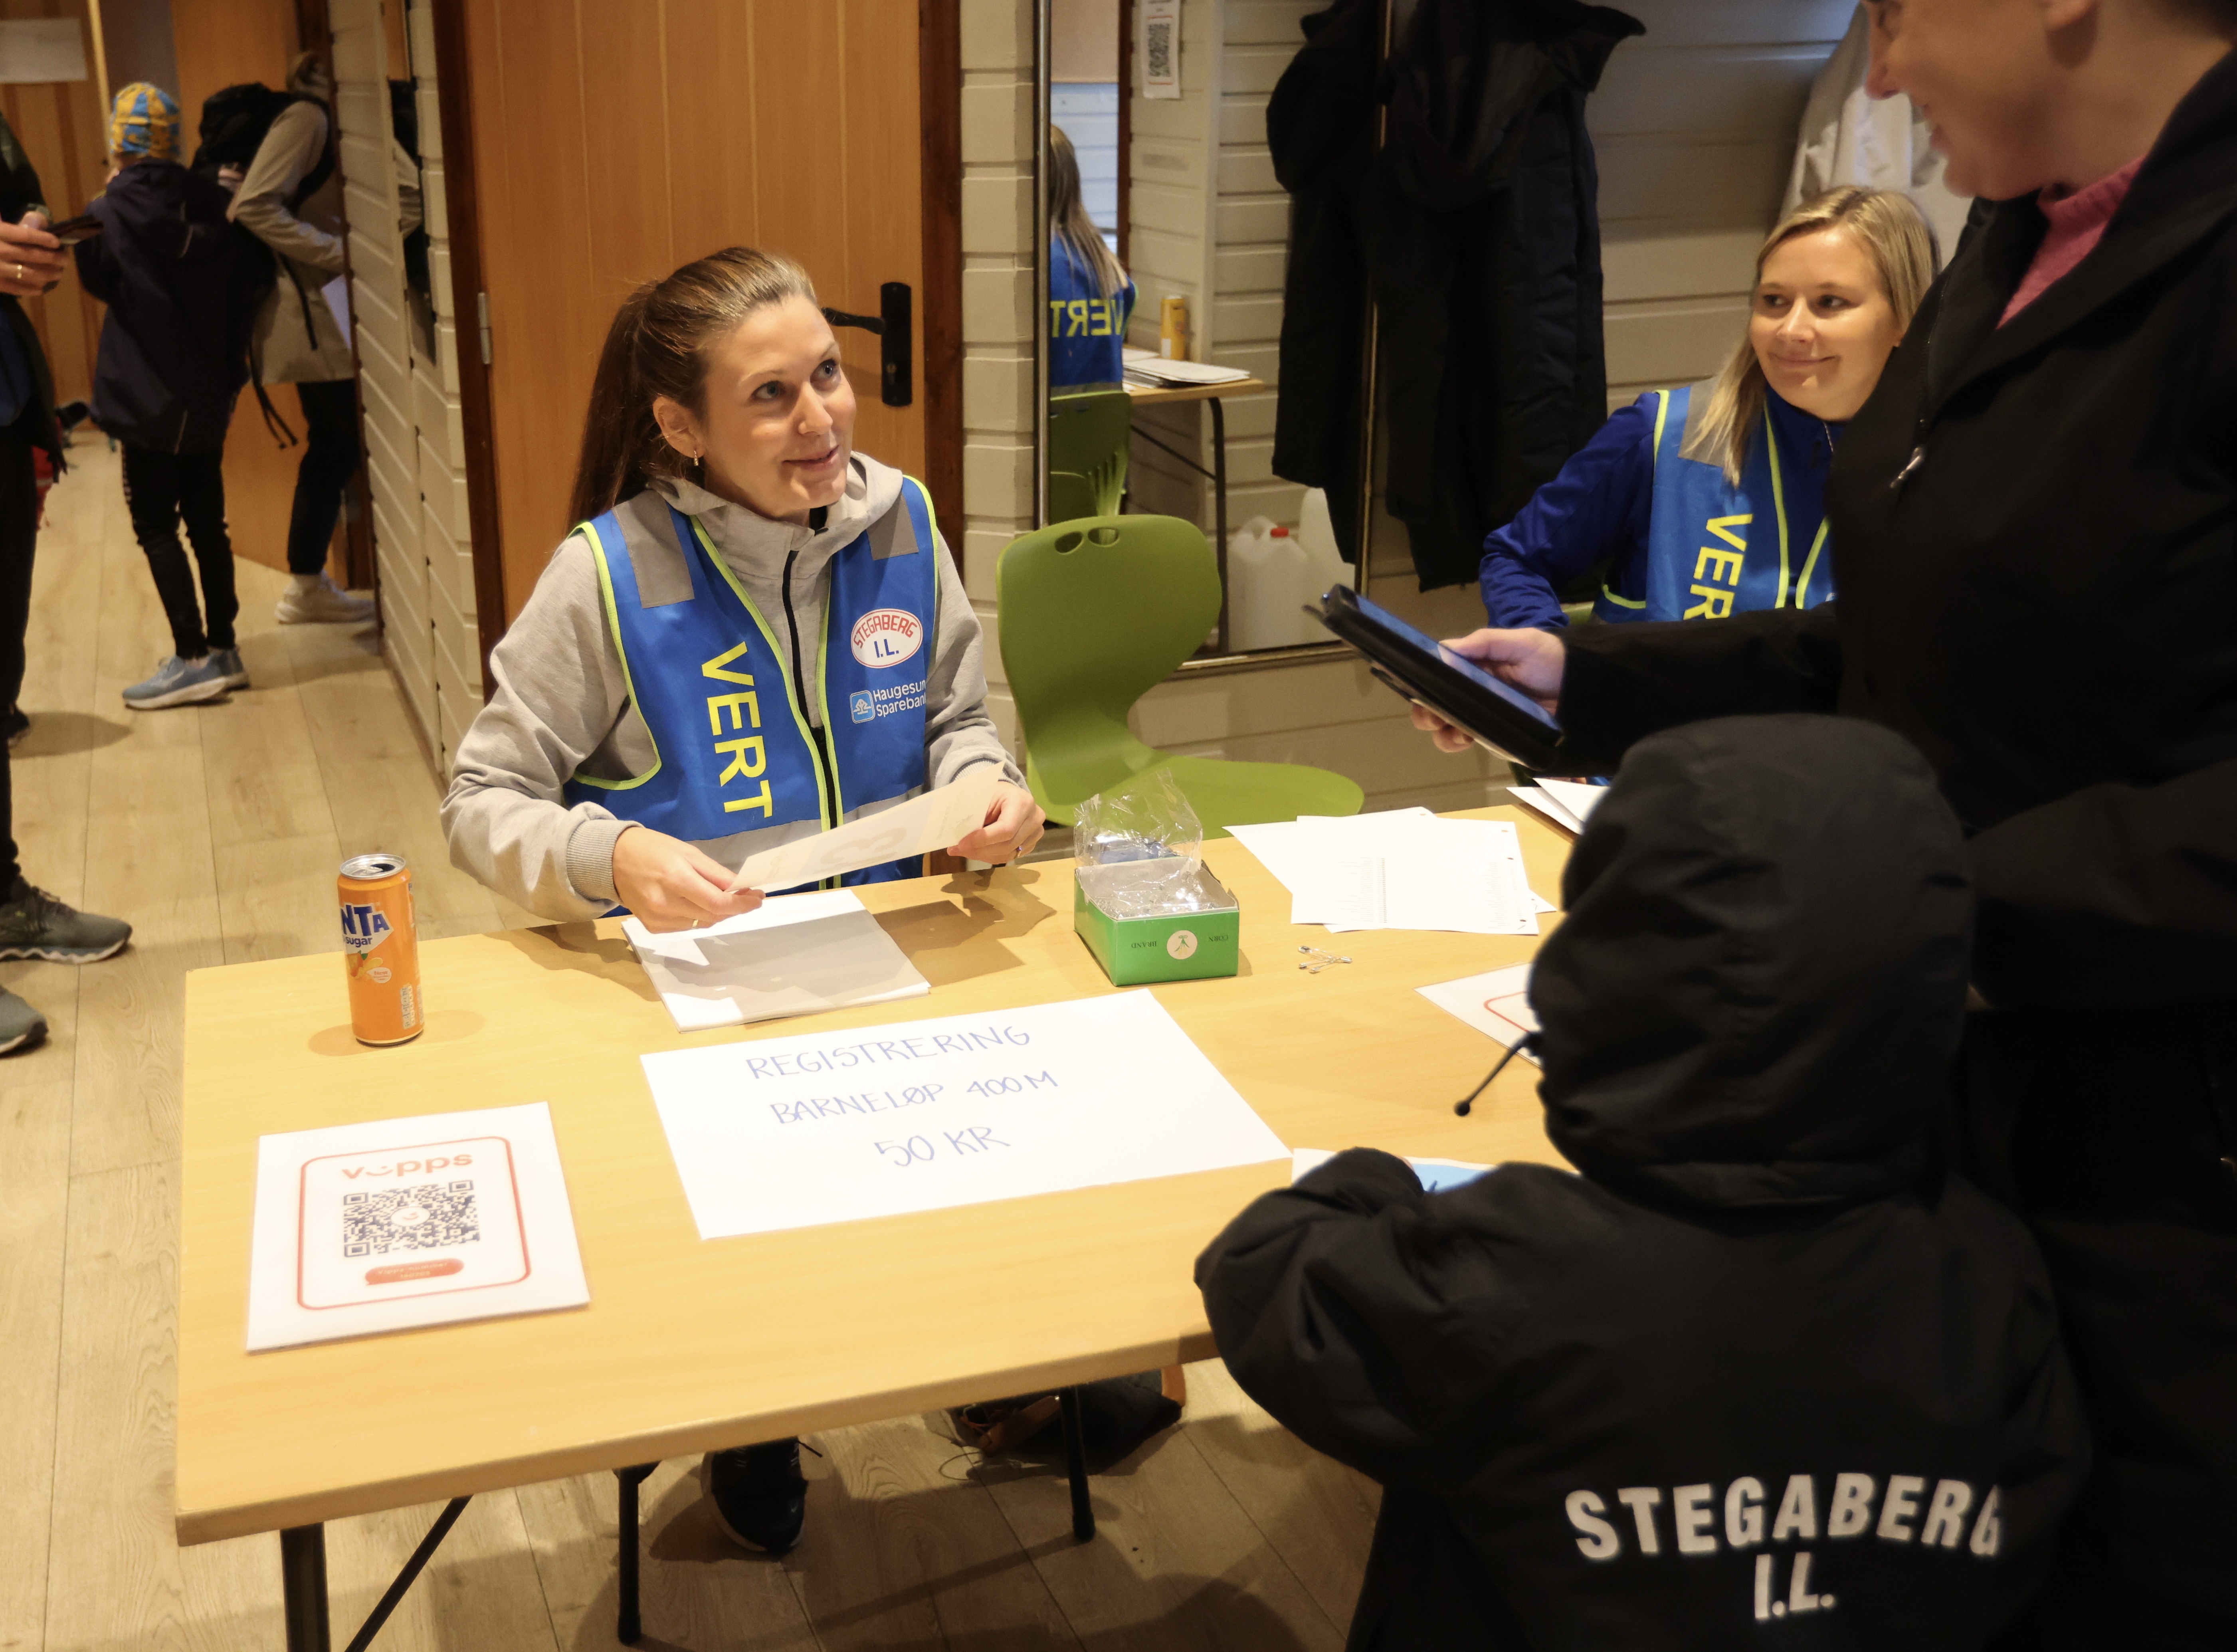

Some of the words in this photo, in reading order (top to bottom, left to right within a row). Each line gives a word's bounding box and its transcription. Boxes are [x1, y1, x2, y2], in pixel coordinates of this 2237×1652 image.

[1683, 513, 1753, 620] VER
[853, 614, 917, 649] STEGABERG
[874, 639, 899, 658] I.L.
[873, 680, 926, 702] Haugesun
[701, 641, 773, 818] VERT
[345, 936, 372, 948] sugar
[746, 1026, 1030, 1079] REGISTRERING
[770, 1084, 944, 1124] BARNELØP
[874, 1135, 935, 1166] 50
[943, 1126, 1011, 1155] KR
[1565, 1472, 1998, 1558] STEGABERG
[1755, 1551, 1835, 1619] I.L.
